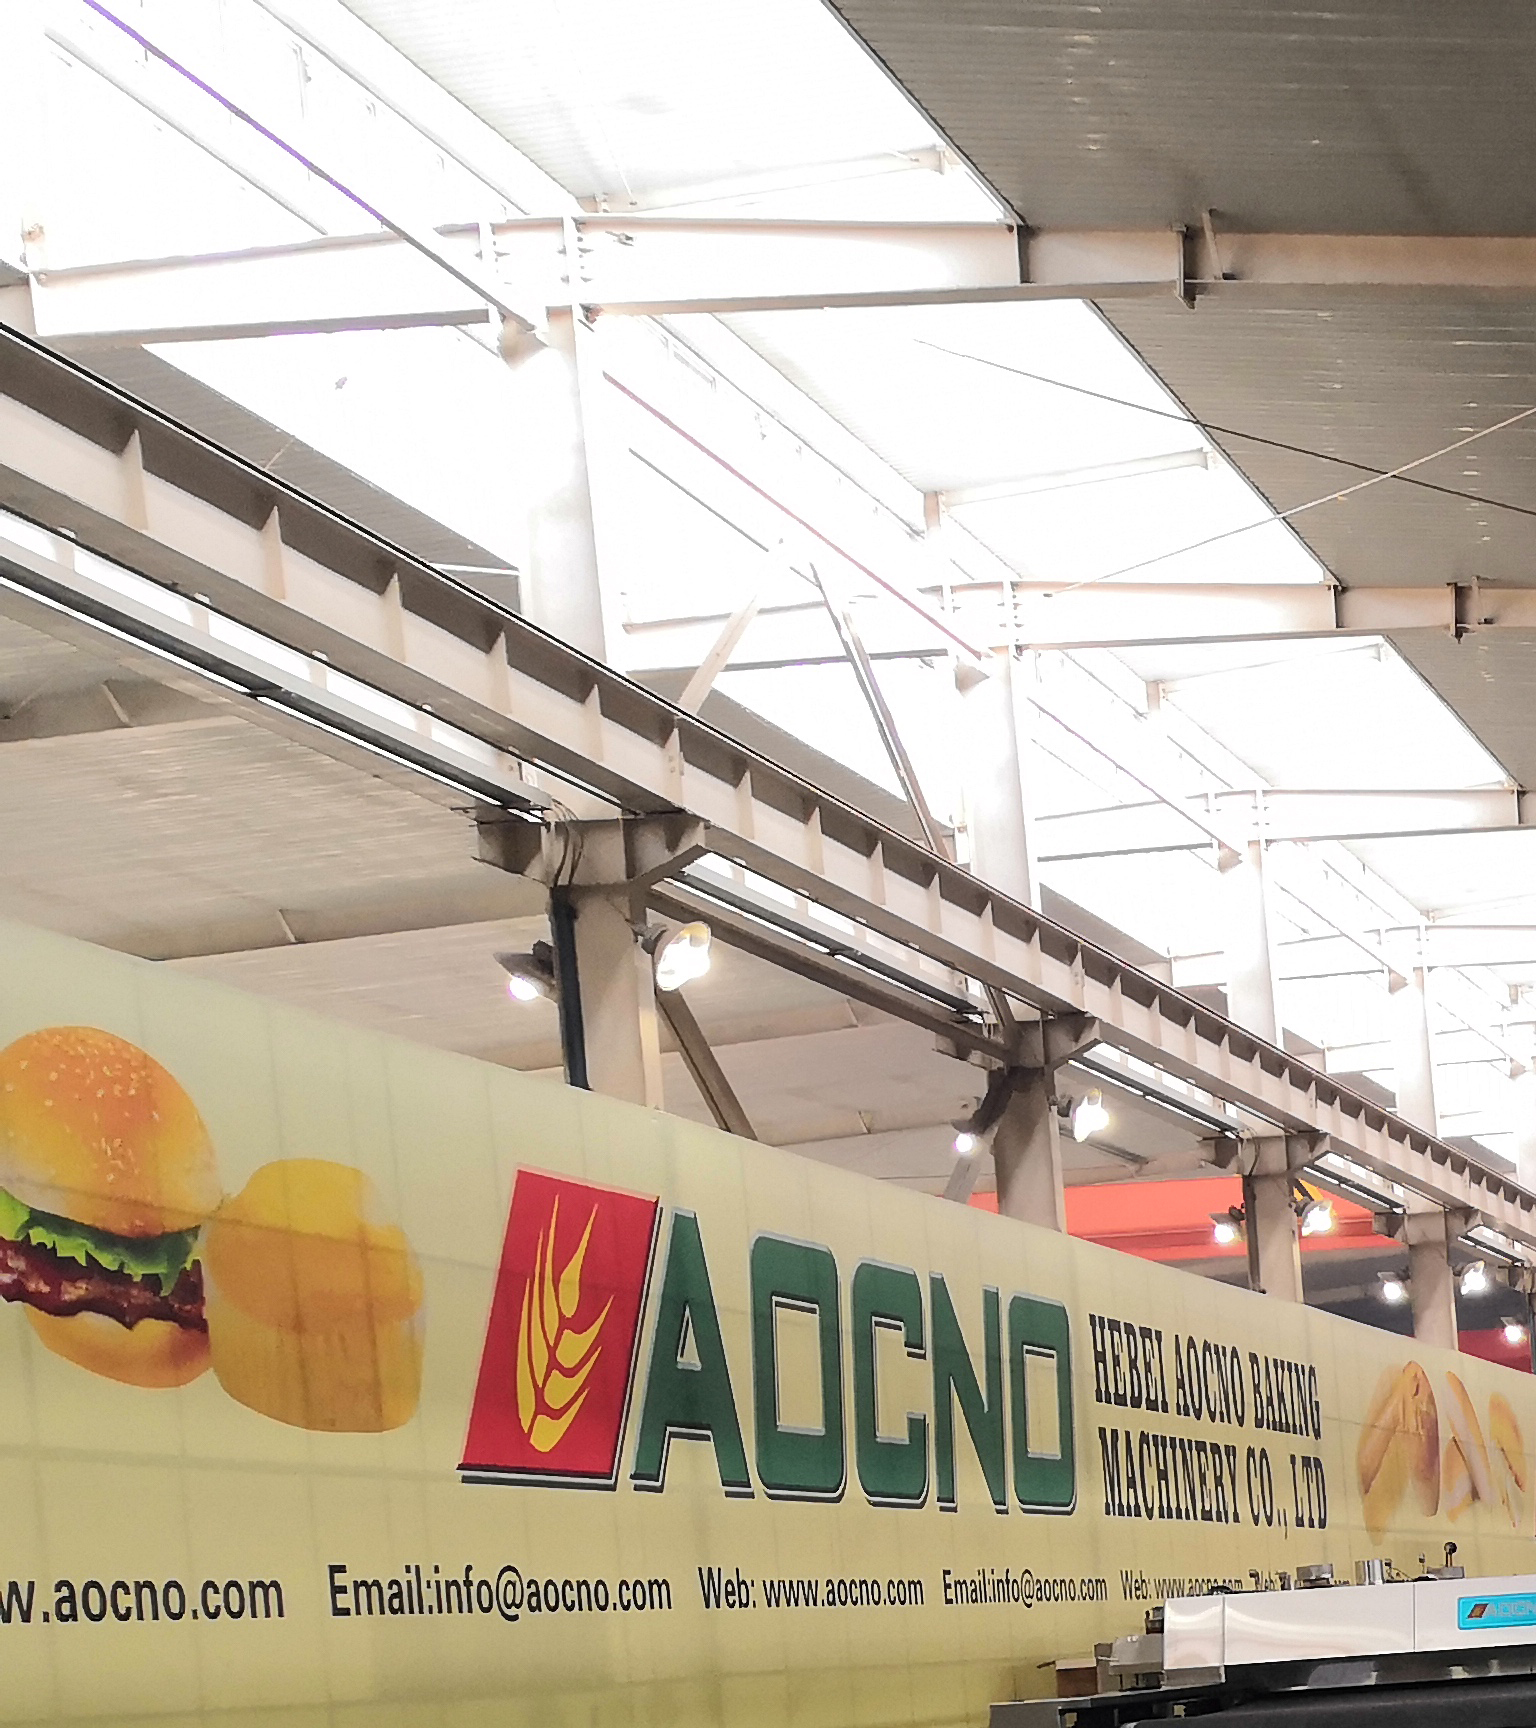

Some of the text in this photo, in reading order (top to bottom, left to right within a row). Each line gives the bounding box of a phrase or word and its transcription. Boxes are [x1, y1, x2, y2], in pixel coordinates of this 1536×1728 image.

[630, 1206, 1078, 1516] AOCNO
[1089, 1313, 1321, 1440] HEBEI AOCNO BAKING
[1098, 1426, 1328, 1539] MACHINERY CO., LTD
[328, 1564, 673, 1622] Email:info@aocno.com
[697, 1566, 757, 1609] Web:
[762, 1578, 925, 1609] www.aocno.com
[942, 1568, 1108, 1608] Email:info@aocno.com
[1119, 1569, 1152, 1600] Web:
